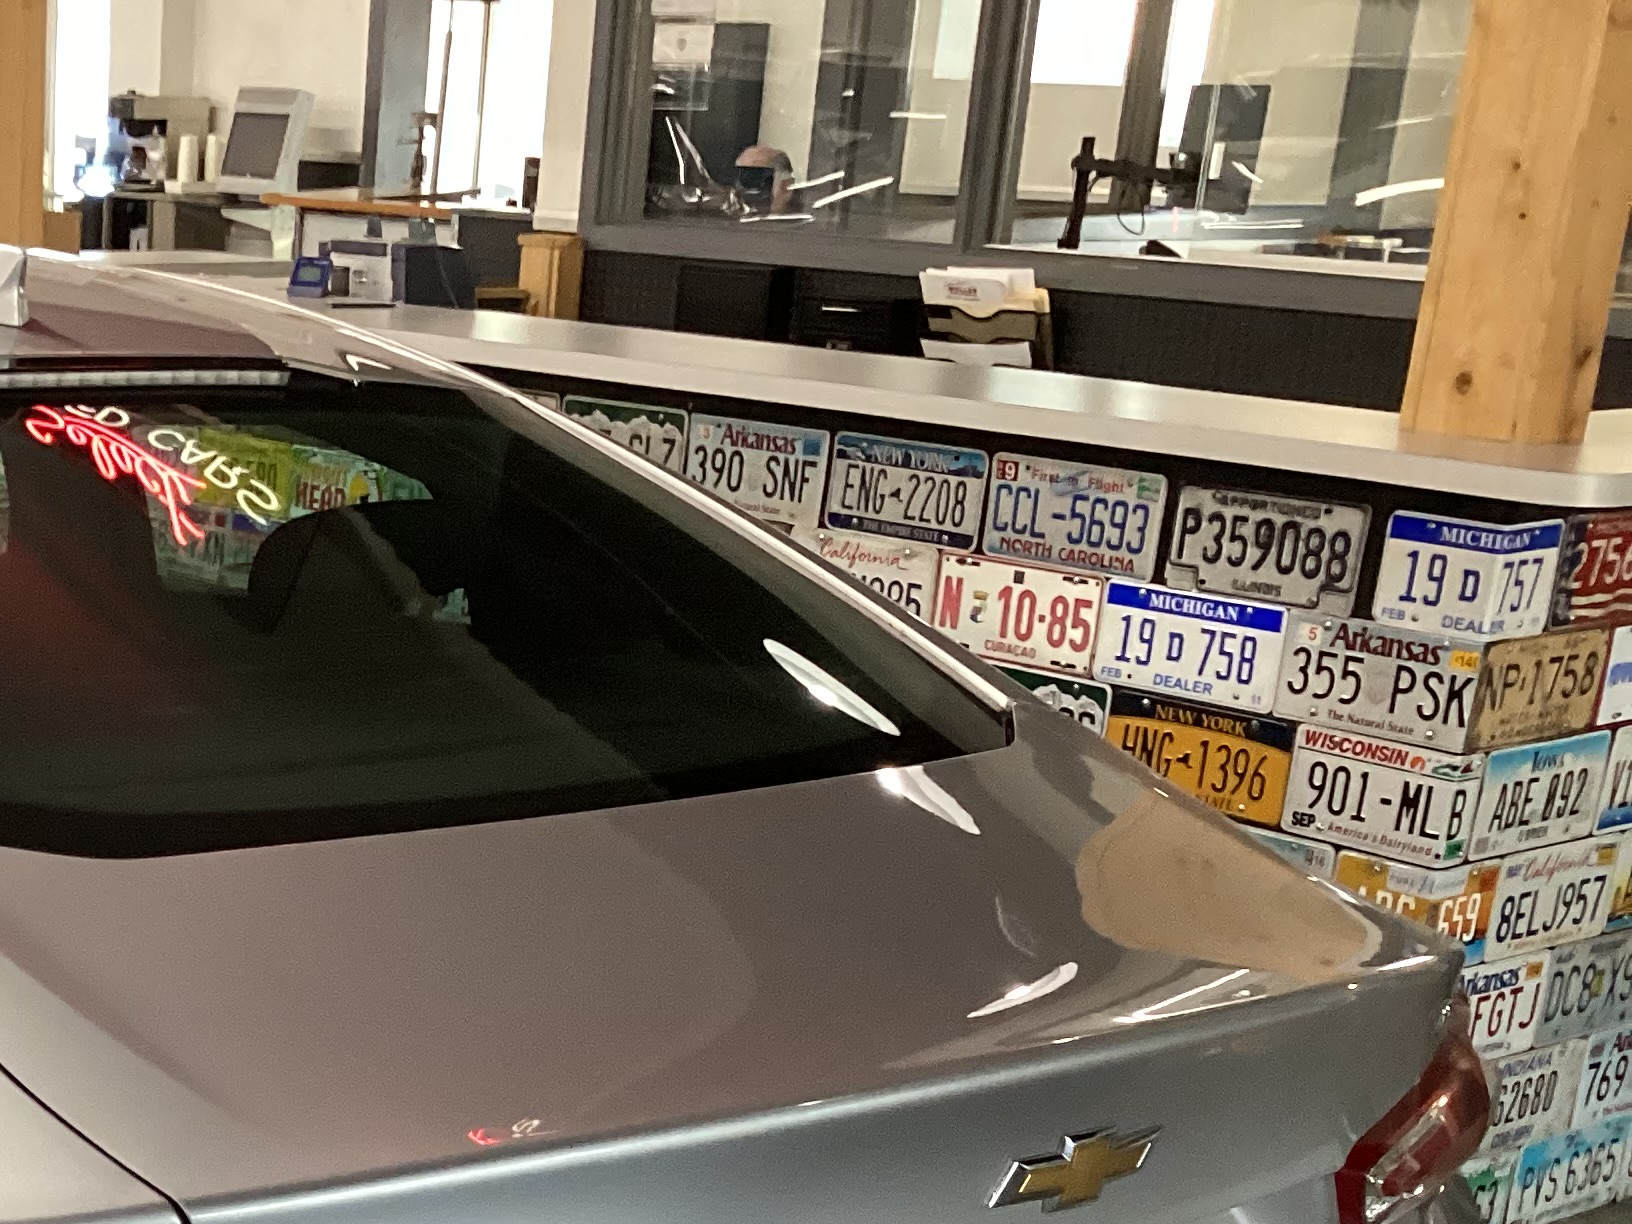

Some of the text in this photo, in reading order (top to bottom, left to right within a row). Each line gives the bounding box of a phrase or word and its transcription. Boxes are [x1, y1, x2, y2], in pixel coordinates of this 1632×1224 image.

[720, 423, 798, 455] Arkansas
[691, 445, 745, 492] 390
[763, 455, 818, 503] SNF
[871, 445, 950, 473] NEW YORK
[1031, 467, 1060, 484] First
[1088, 476, 1125, 494] Flight
[992, 483, 1150, 555] CCL-5693
[1440, 526, 1532, 549] MICHIGAN
[819, 535, 910, 571] California
[1000, 536, 1135, 573] NORTH CAROLINA
[1177, 507, 1352, 584] P359088
[1232, 578, 1282, 597] ILLINOIS
[1399, 550, 1544, 616] 19 D 757
[939, 575, 964, 630] N
[1149, 593, 1240, 621] MICHIGAN
[1381, 607, 1505, 635] FEB DEALER
[1115, 614, 1257, 685] 19 D 758
[1308, 627, 1318, 641] 5
[1329, 623, 1443, 667] Arkansas
[1100, 666, 1122, 679] FEB
[1153, 673, 1213, 696] DEALER
[1287, 646, 1365, 705] 355
[1388, 663, 1475, 728] PSK
[1155, 704, 1247, 737] NEW YORK
[1327, 709, 1414, 736] The Natural State
[1305, 729, 1410, 768] WISCONSIN
[1197, 739, 1268, 801] 1396
[1488, 777, 1540, 834] ABE
[1291, 811, 1433, 857] SEP America's Dairyland
[1524, 848, 1596, 883] California
[1495, 874, 1607, 943] 8ELJ957
[1584, 1055, 1629, 1107] 769
